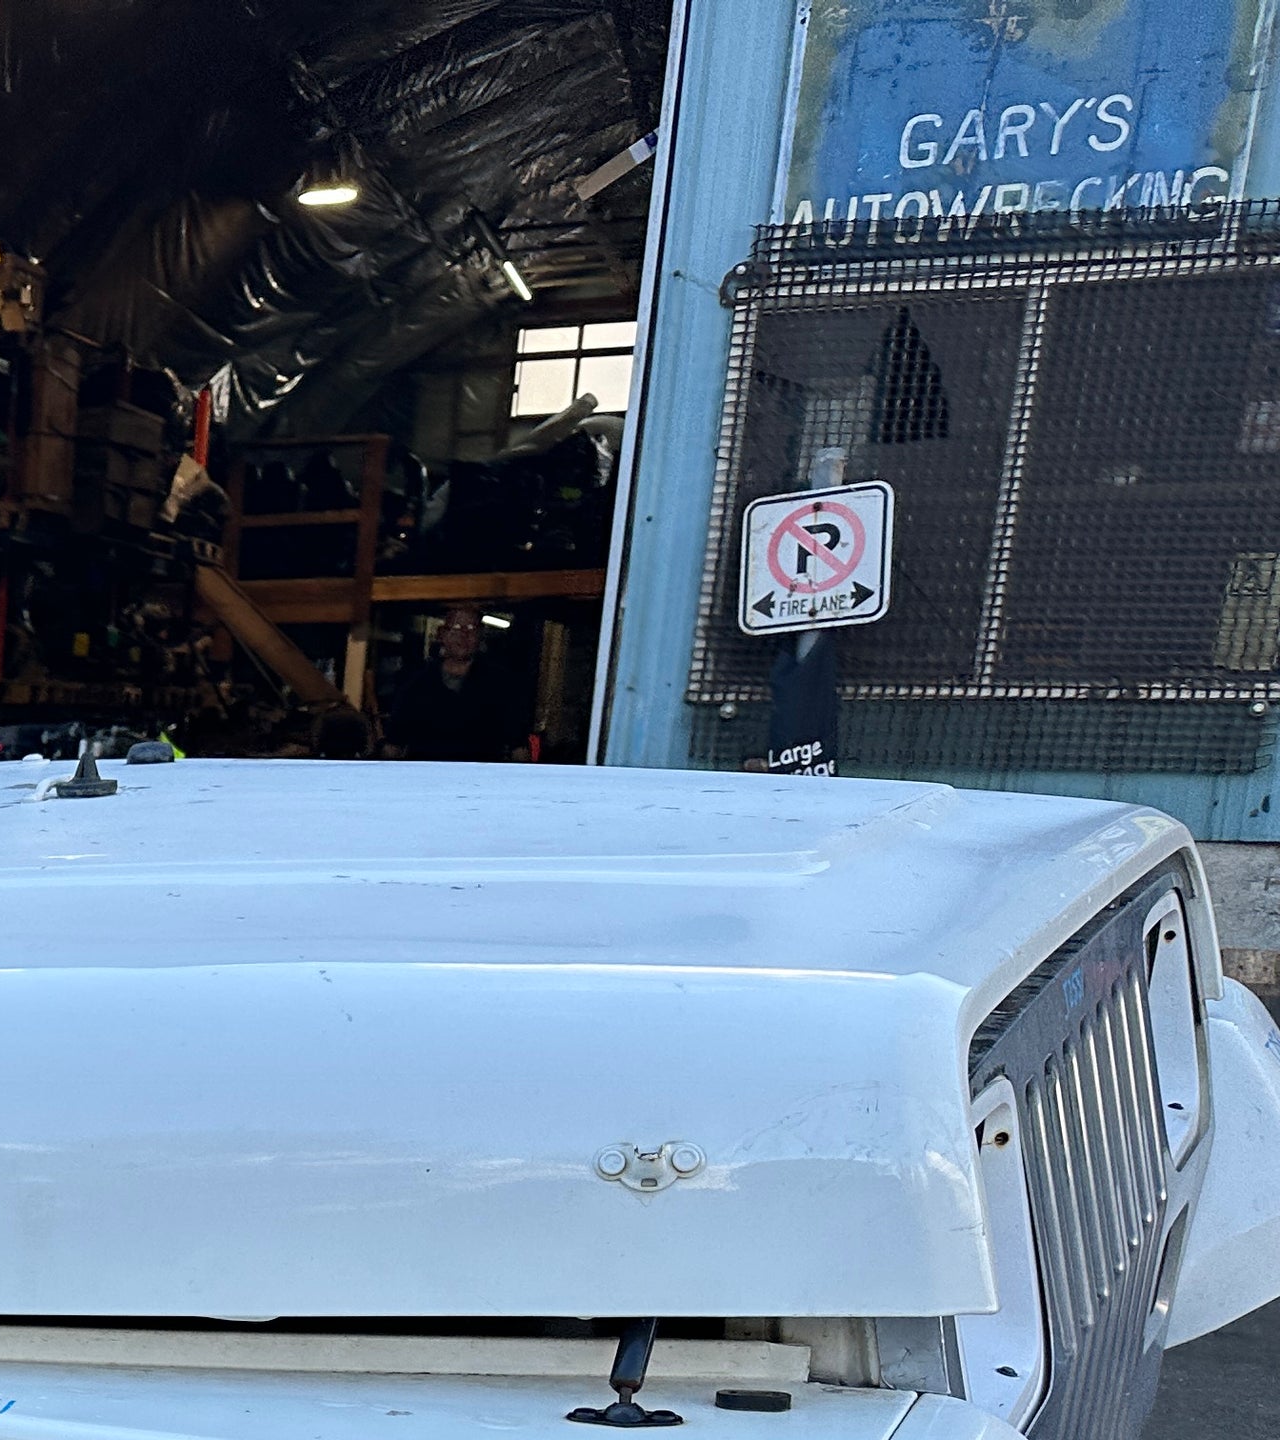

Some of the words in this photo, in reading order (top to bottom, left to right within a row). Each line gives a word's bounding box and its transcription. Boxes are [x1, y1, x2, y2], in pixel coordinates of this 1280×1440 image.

[899, 94, 1133, 168] GARY'S
[779, 599, 809, 617] FIRE
[768, 741, 823, 768] Large
